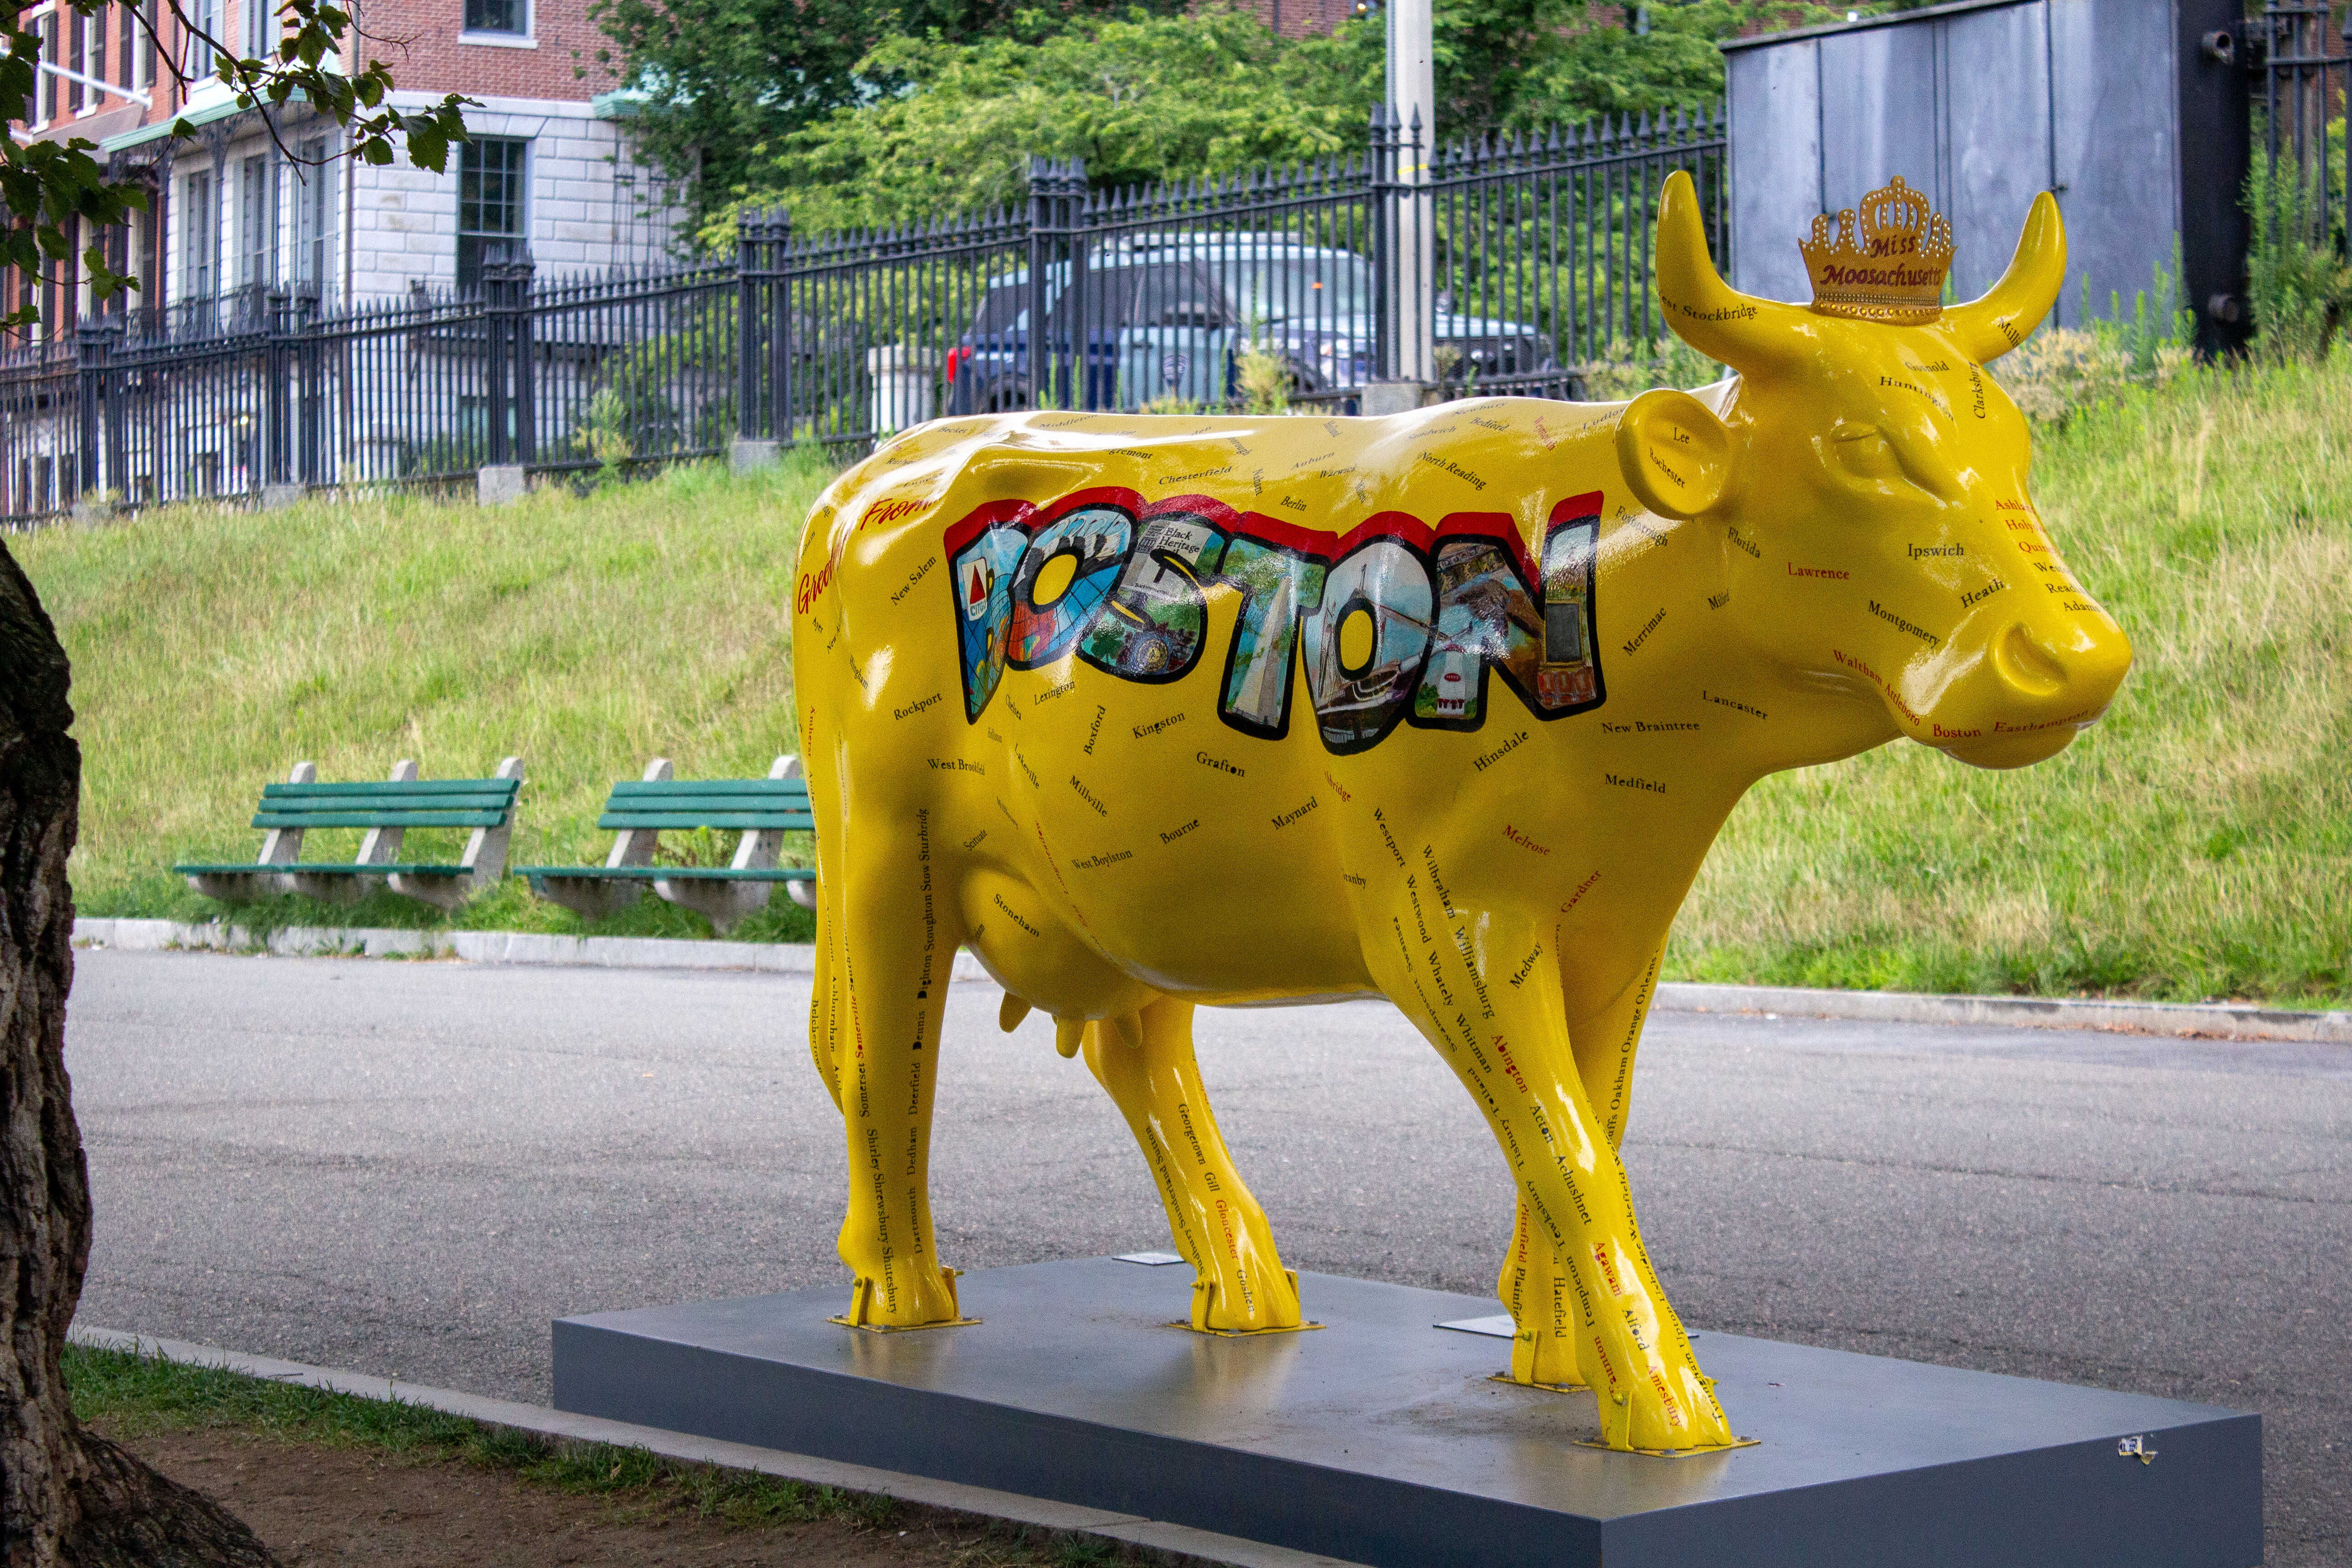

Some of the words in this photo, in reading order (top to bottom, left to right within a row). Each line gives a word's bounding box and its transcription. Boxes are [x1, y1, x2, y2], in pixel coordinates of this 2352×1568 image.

[1869, 234, 1916, 258] Miss
[1820, 263, 1941, 287] Moosachusetts
[1682, 303, 1759, 322] Stockbridge
[1879, 376, 1954, 422] Huntington
[1039, 414, 1097, 428] Middleton
[1470, 417, 1509, 432] Bedford
[1673, 427, 1689, 443] Lee
[1159, 466, 1232, 485] Chesterfield
[1252, 467, 1264, 496] Nahant
[1291, 452, 1334, 469] Auburn
[1419, 452, 1446, 468] North
[1446, 462, 1487, 491] Reading
[1650, 447, 1685, 488] Rochester
[860, 498, 942, 530] From
[1280, 495, 1307, 512] Berlin
[1158, 537, 1200, 554] Heritage
[1164, 527, 1193, 540] Black
[1616, 505, 1668, 546] Foxborough
[1728, 527, 1760, 558] Florida
[1788, 562, 1850, 580] Lawrence
[1907, 544, 1965, 560] Ipswich
[892, 581, 914, 606] New
[907, 556, 937, 586] Salem
[1960, 579, 2004, 609] Heath
[942, 485, 1605, 756] BOSTON
[1622, 607, 1667, 657] Merrimac
[1868, 600, 1940, 649] Montgomery
[849, 654, 869, 689] Hingham
[1034, 680, 1076, 706] Lexington
[893, 692, 943, 721] Rockport
[1005, 694, 1022, 721] Chelsea
[1703, 690, 1768, 720] Lancaster
[1833, 650, 1882, 686] Waltham
[1884, 684, 1920, 727] Attleboro
[1933, 724, 1981, 738] Boston
[1994, 709, 2089, 734] Easthampton
[807, 706, 816, 757] Amherst
[1083, 705, 1106, 756] Boxford
[1132, 711, 1185, 740] Kingston
[1602, 722, 1631, 734] New
[1635, 721, 1700, 733] Braintree
[927, 758, 956, 770] West
[958, 759, 986, 776] Brookfield
[1014, 742, 1040, 790] Lakeville
[1196, 752, 1245, 778] Grafton
[1473, 730, 1529, 772] Hinsdale
[1070, 775, 1107, 817] Millville
[1605, 773, 1666, 794] Medfield
[1159, 819, 1200, 845] Bourne
[1271, 796, 1319, 831] Maynard
[963, 828, 988, 851] Scituate
[1072, 859, 1092, 870] West
[1091, 848, 1133, 868] Boylston
[1503, 825, 1550, 856] Melrose
[921, 865, 931, 892] Stow
[1561, 870, 1602, 914] Gardner
[921, 894, 937, 951] Stoughton
[993, 893, 1040, 938] Stoneham
[1373, 807, 1406, 868] Westport
[1406, 874, 1431, 944] Westwood
[1428, 950, 1453, 1008] Whately
[1456, 1013, 1492, 1074] Whitman
[1392, 916, 1413, 974] Swansea
[846, 956, 855, 992] South
[917, 955, 933, 1000] Dighton
[1423, 844, 1456, 920] Wilbraham
[1455, 925, 1495, 1020] Williamsburg
[1491, 1035, 1529, 1094] Abington
[1509, 940, 1544, 989] Medway
[828, 975, 837, 1053] Ashburnham
[852, 995, 865, 1059] Somerville
[912, 1011, 926, 1051] Dennis
[1414, 978, 1458, 1054] Swampscott
[1610, 1056, 1628, 1110] Oakham
[1621, 1009, 1641, 1054] Orange
[1635, 956, 1657, 1006] Orleans
[811, 999, 823, 1074] Belchertown
[859, 1062, 870, 1118] Somerset
[908, 1062, 921, 1116] Deerfield
[1467, 1067, 1499, 1118] Tolland
[1145, 1126, 1163, 1165] Sutton
[1500, 1118, 1526, 1172] Tisbury
[1530, 1105, 1554, 1145] Acton
[866, 1129, 881, 1171] Shirley
[906, 1126, 917, 1176] Dedham
[873, 1172, 889, 1245] Shrewsbury
[1159, 1165, 1186, 1229] Sunderland
[1178, 1103, 1206, 1165] Georgetown
[1204, 1172, 1220, 1193] Gill
[1215, 1199, 1238, 1260] Gloucester
[1236, 1269, 1255, 1313] Goshen
[1525, 1179, 1566, 1252] Tewksbury
[1618, 1172, 1637, 1242] Wakefield
[906, 1186, 922, 1254] Dartmouth
[1518, 1203, 1529, 1263] Pittsfield
[1184, 1229, 1205, 1275] Sudbury
[1636, 1242, 1665, 1302] Uxbridge
[881, 1245, 898, 1314] Shutesbury
[1512, 1266, 1526, 1329] Plainfield
[1566, 1255, 1595, 1328] Templeton
[1594, 1242, 1621, 1297] Agawam
[1621, 1310, 1650, 1352] Alford
[1646, 1363, 1683, 1428] Amesbury
[1666, 1305, 1686, 1349] Upton
[1594, 1335, 1617, 1399] Taunton
[1685, 1352, 1723, 1424] Tyringham
